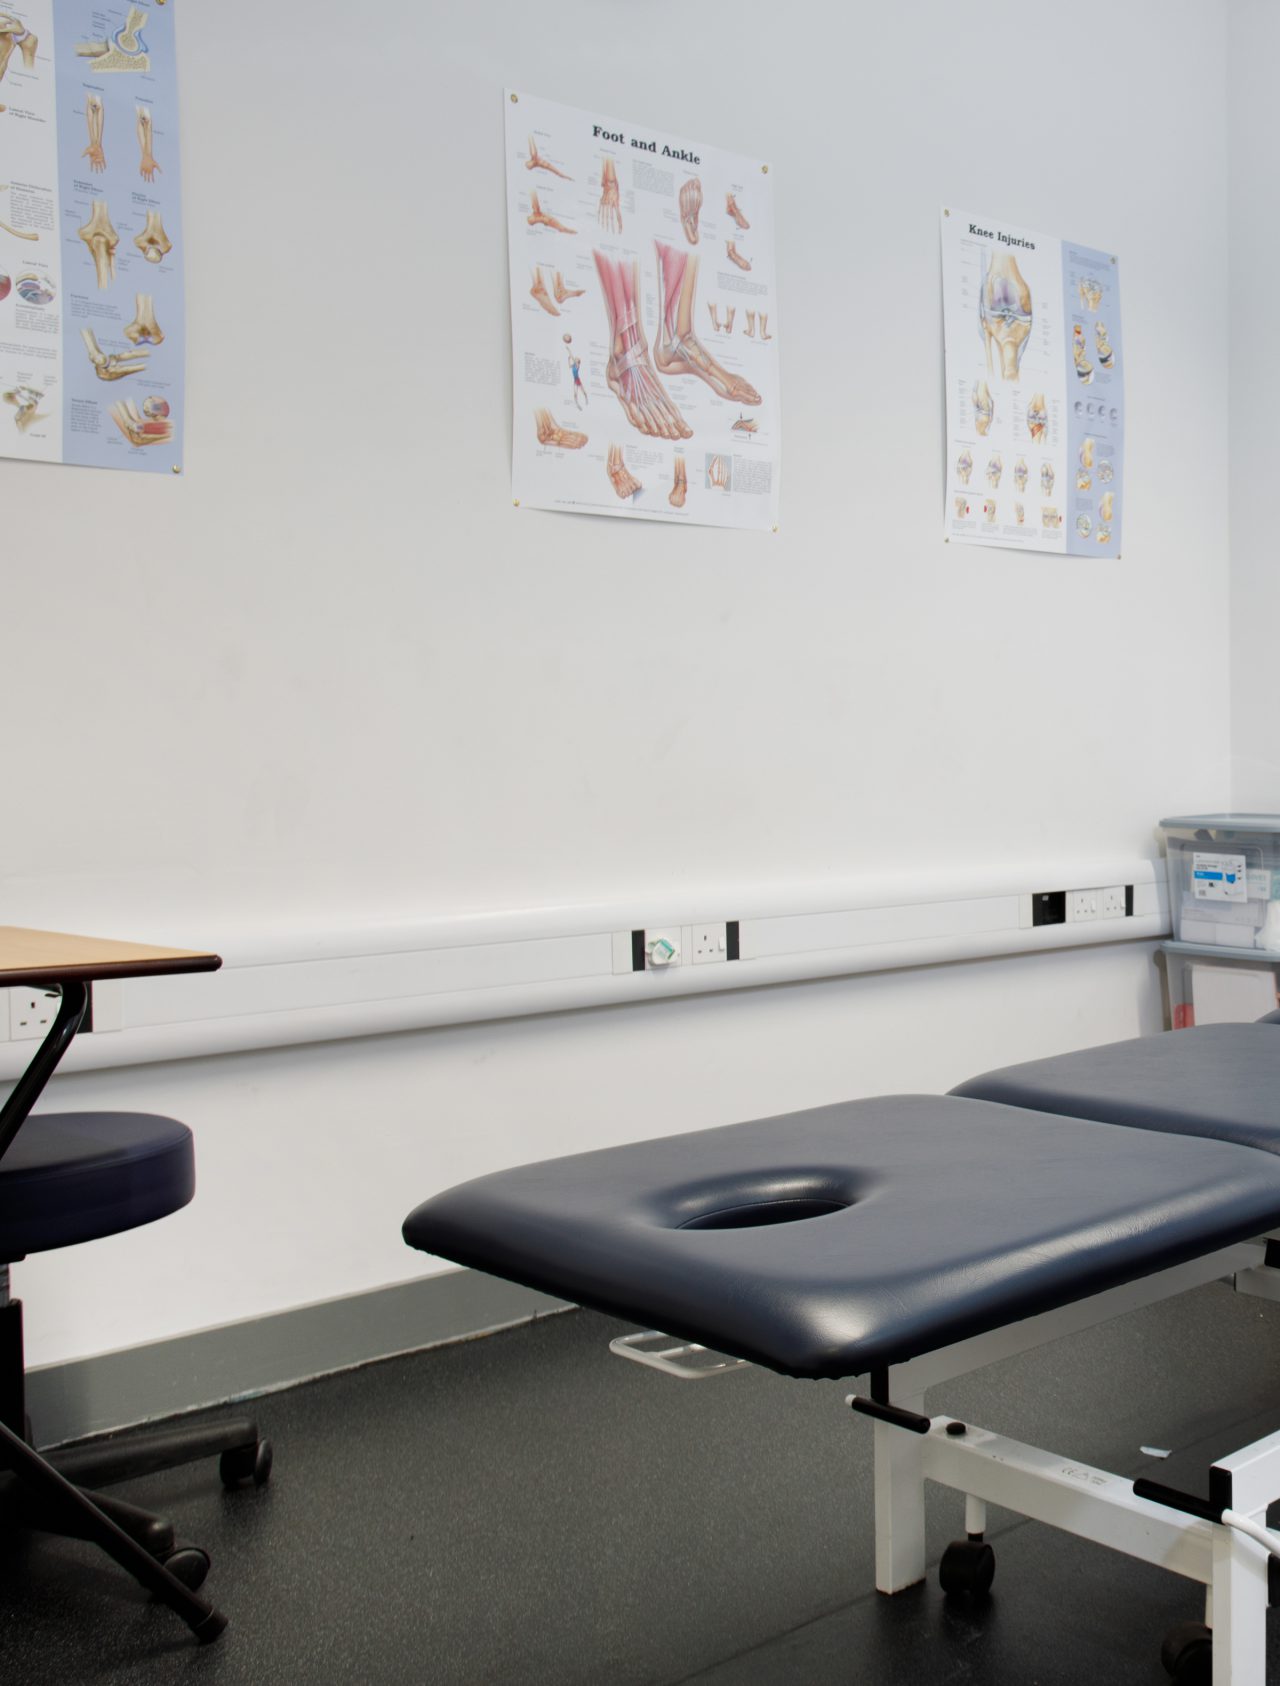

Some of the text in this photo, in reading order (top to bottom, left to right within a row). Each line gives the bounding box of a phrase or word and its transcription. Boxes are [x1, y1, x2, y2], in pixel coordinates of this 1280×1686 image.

[592, 125, 701, 165] Foot and Ankle
[969, 223, 994, 239] Knee
[997, 231, 1036, 250] Injuries
